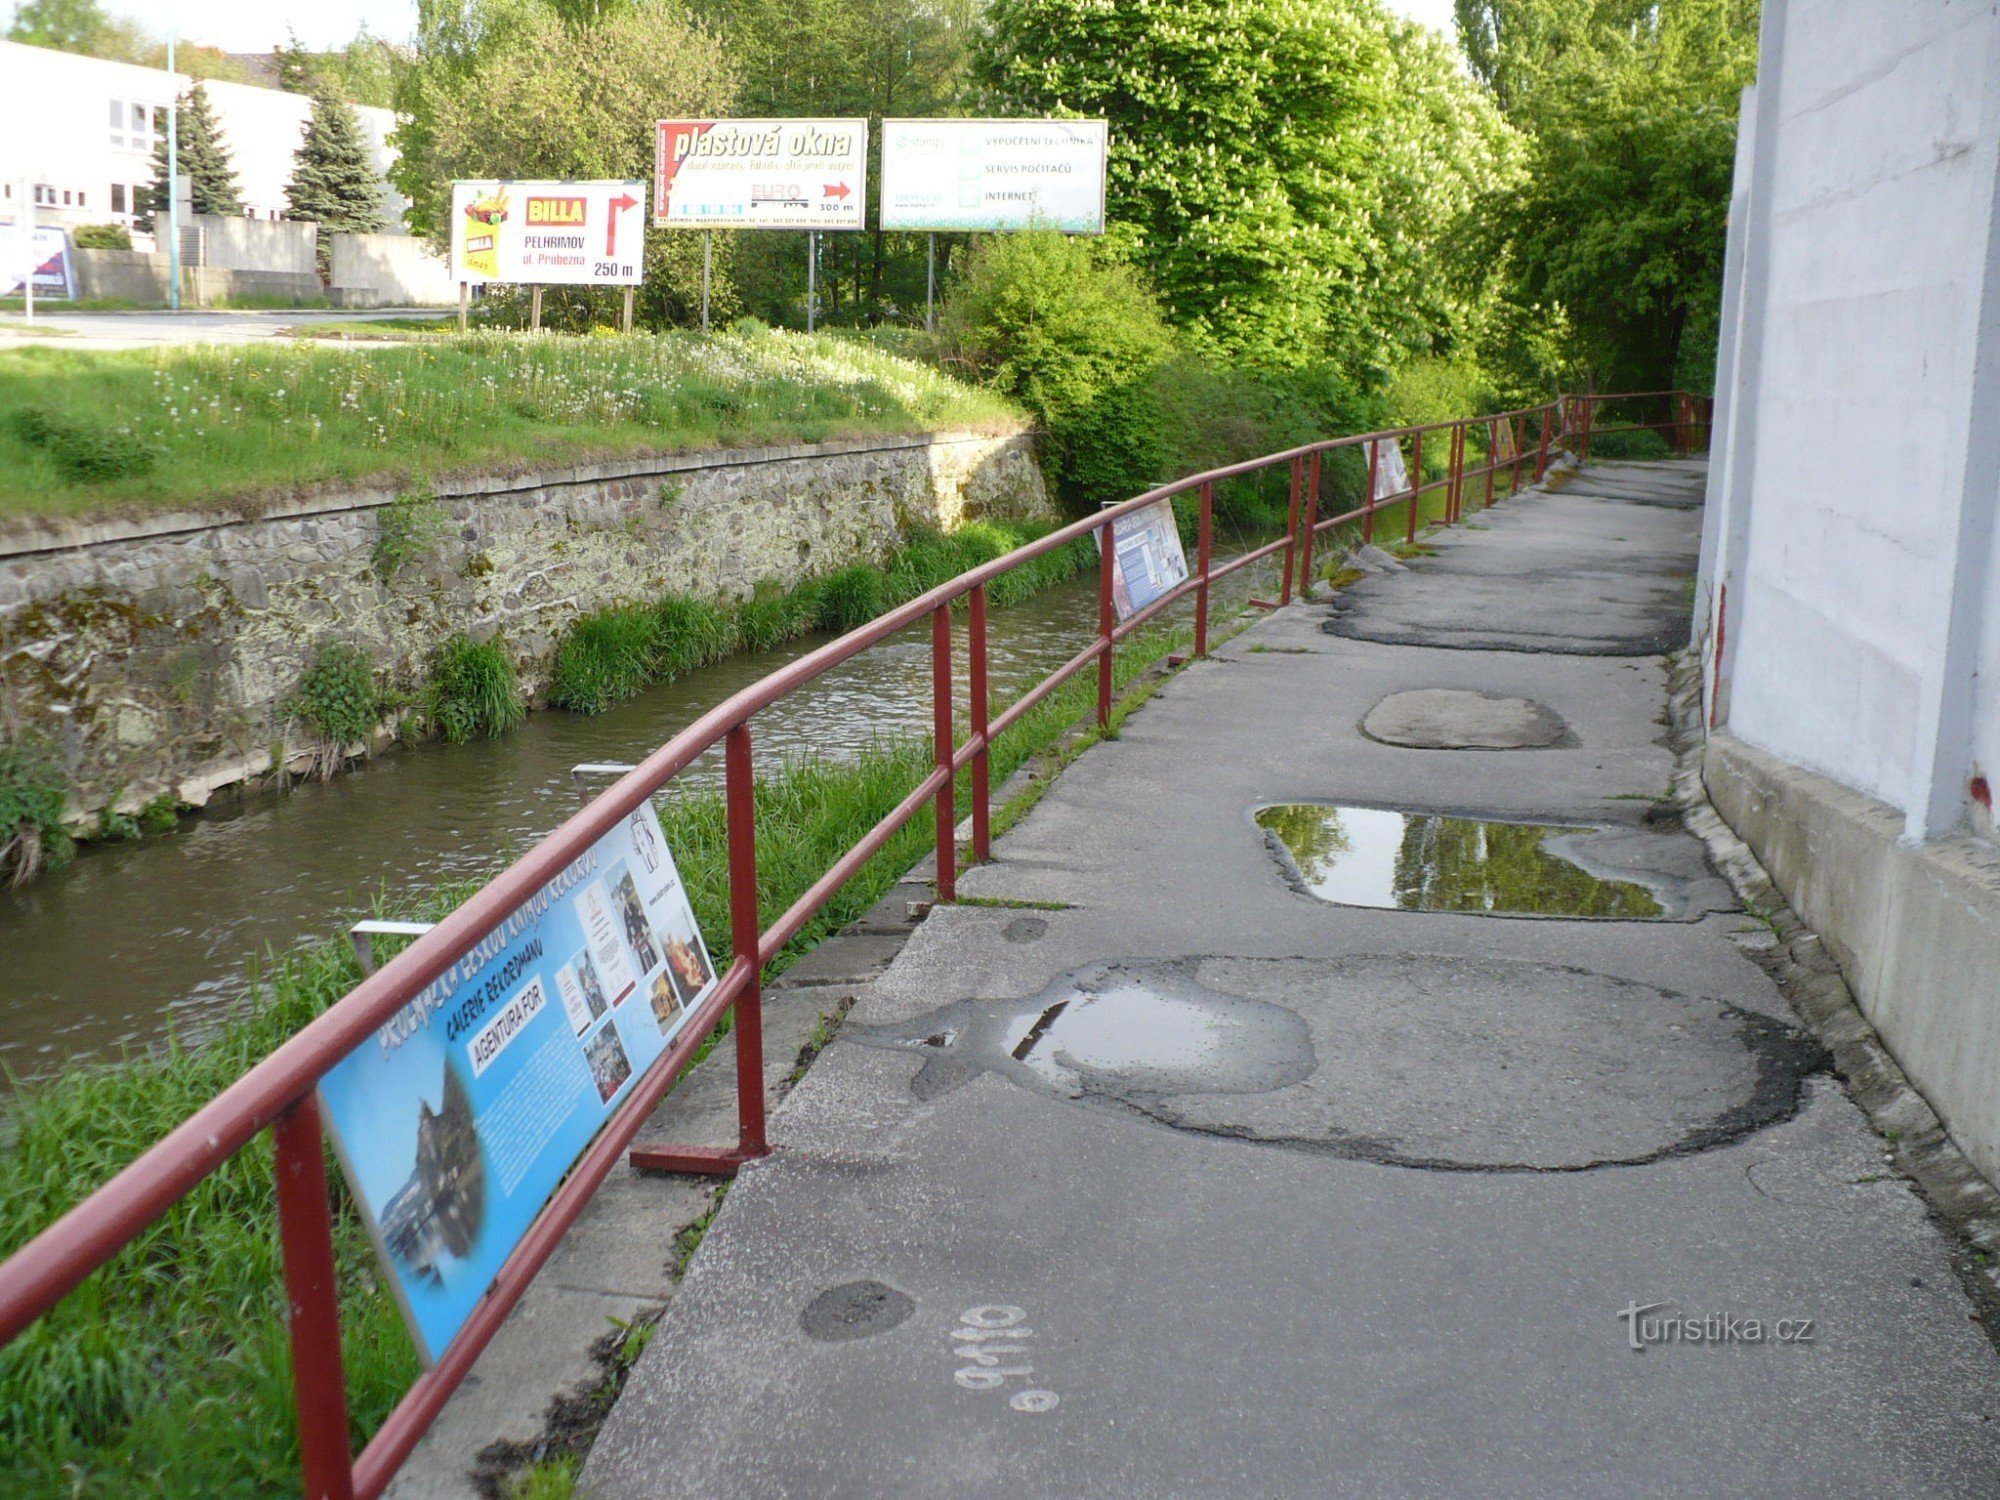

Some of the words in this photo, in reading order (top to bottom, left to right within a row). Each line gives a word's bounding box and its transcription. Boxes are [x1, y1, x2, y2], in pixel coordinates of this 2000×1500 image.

[673, 125, 782, 161] plastová
[789, 126, 851, 156] okna
[985, 164, 1019, 174] SERVIS
[985, 191, 1033, 201] INTERNET
[528, 199, 584, 222] BILLA
[524, 236, 585, 249] PELHRIMOV
[594, 262, 618, 276] 250
[622, 265, 633, 276] m
[446, 988, 486, 1042] GALERIE
[474, 1004, 524, 1069] AGENTURA
[521, 984, 543, 1018] FOR
